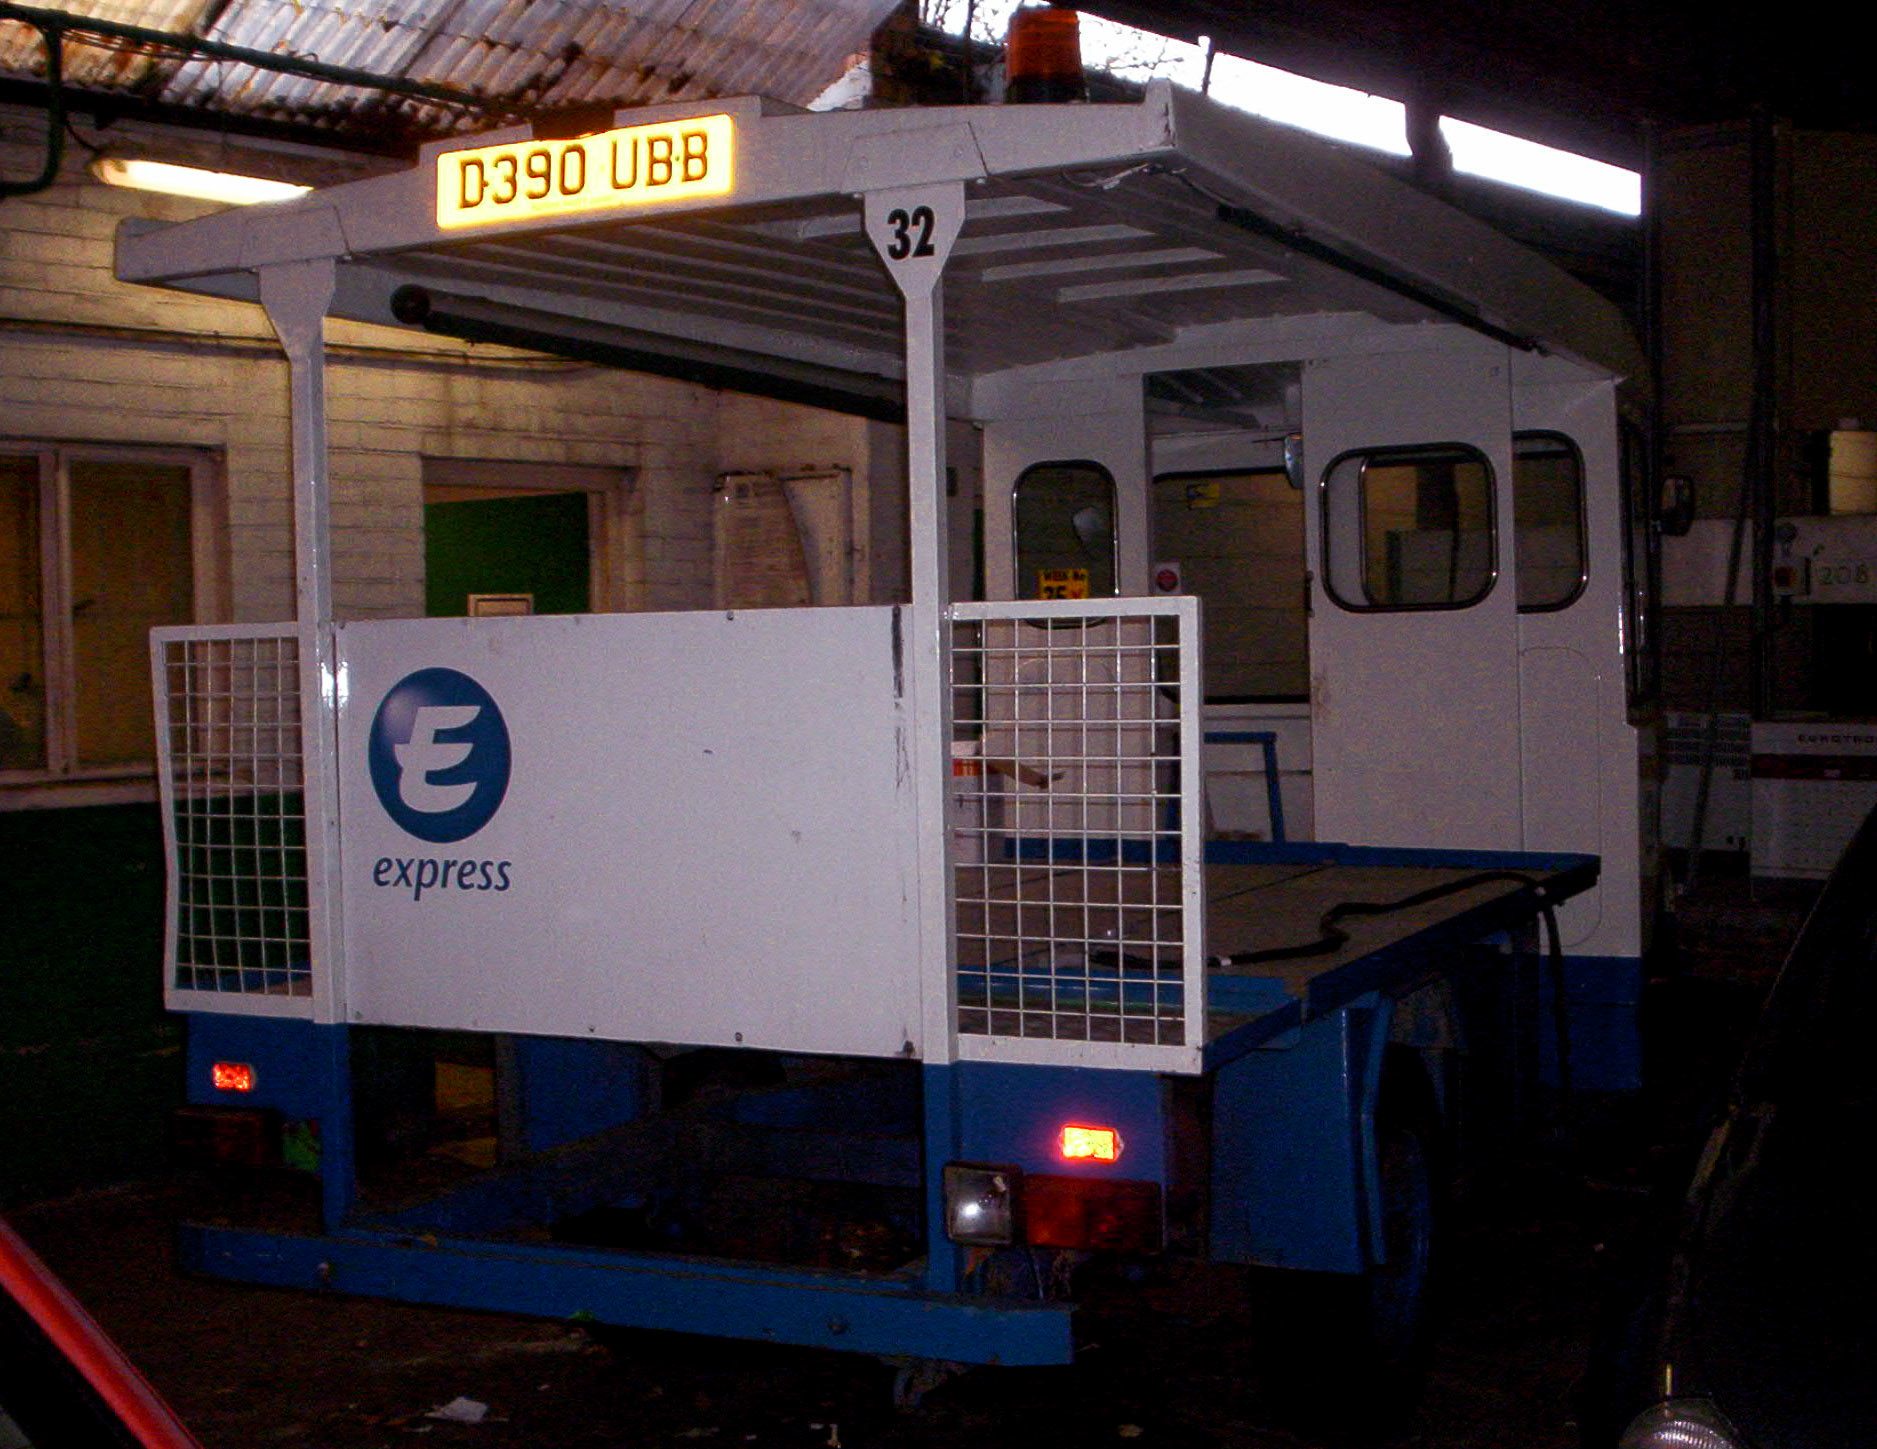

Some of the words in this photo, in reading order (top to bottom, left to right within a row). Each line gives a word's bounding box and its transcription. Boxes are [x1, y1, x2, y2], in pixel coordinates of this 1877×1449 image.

[611, 130, 708, 190] UBB
[887, 205, 935, 260] 32
[373, 856, 512, 901] express
